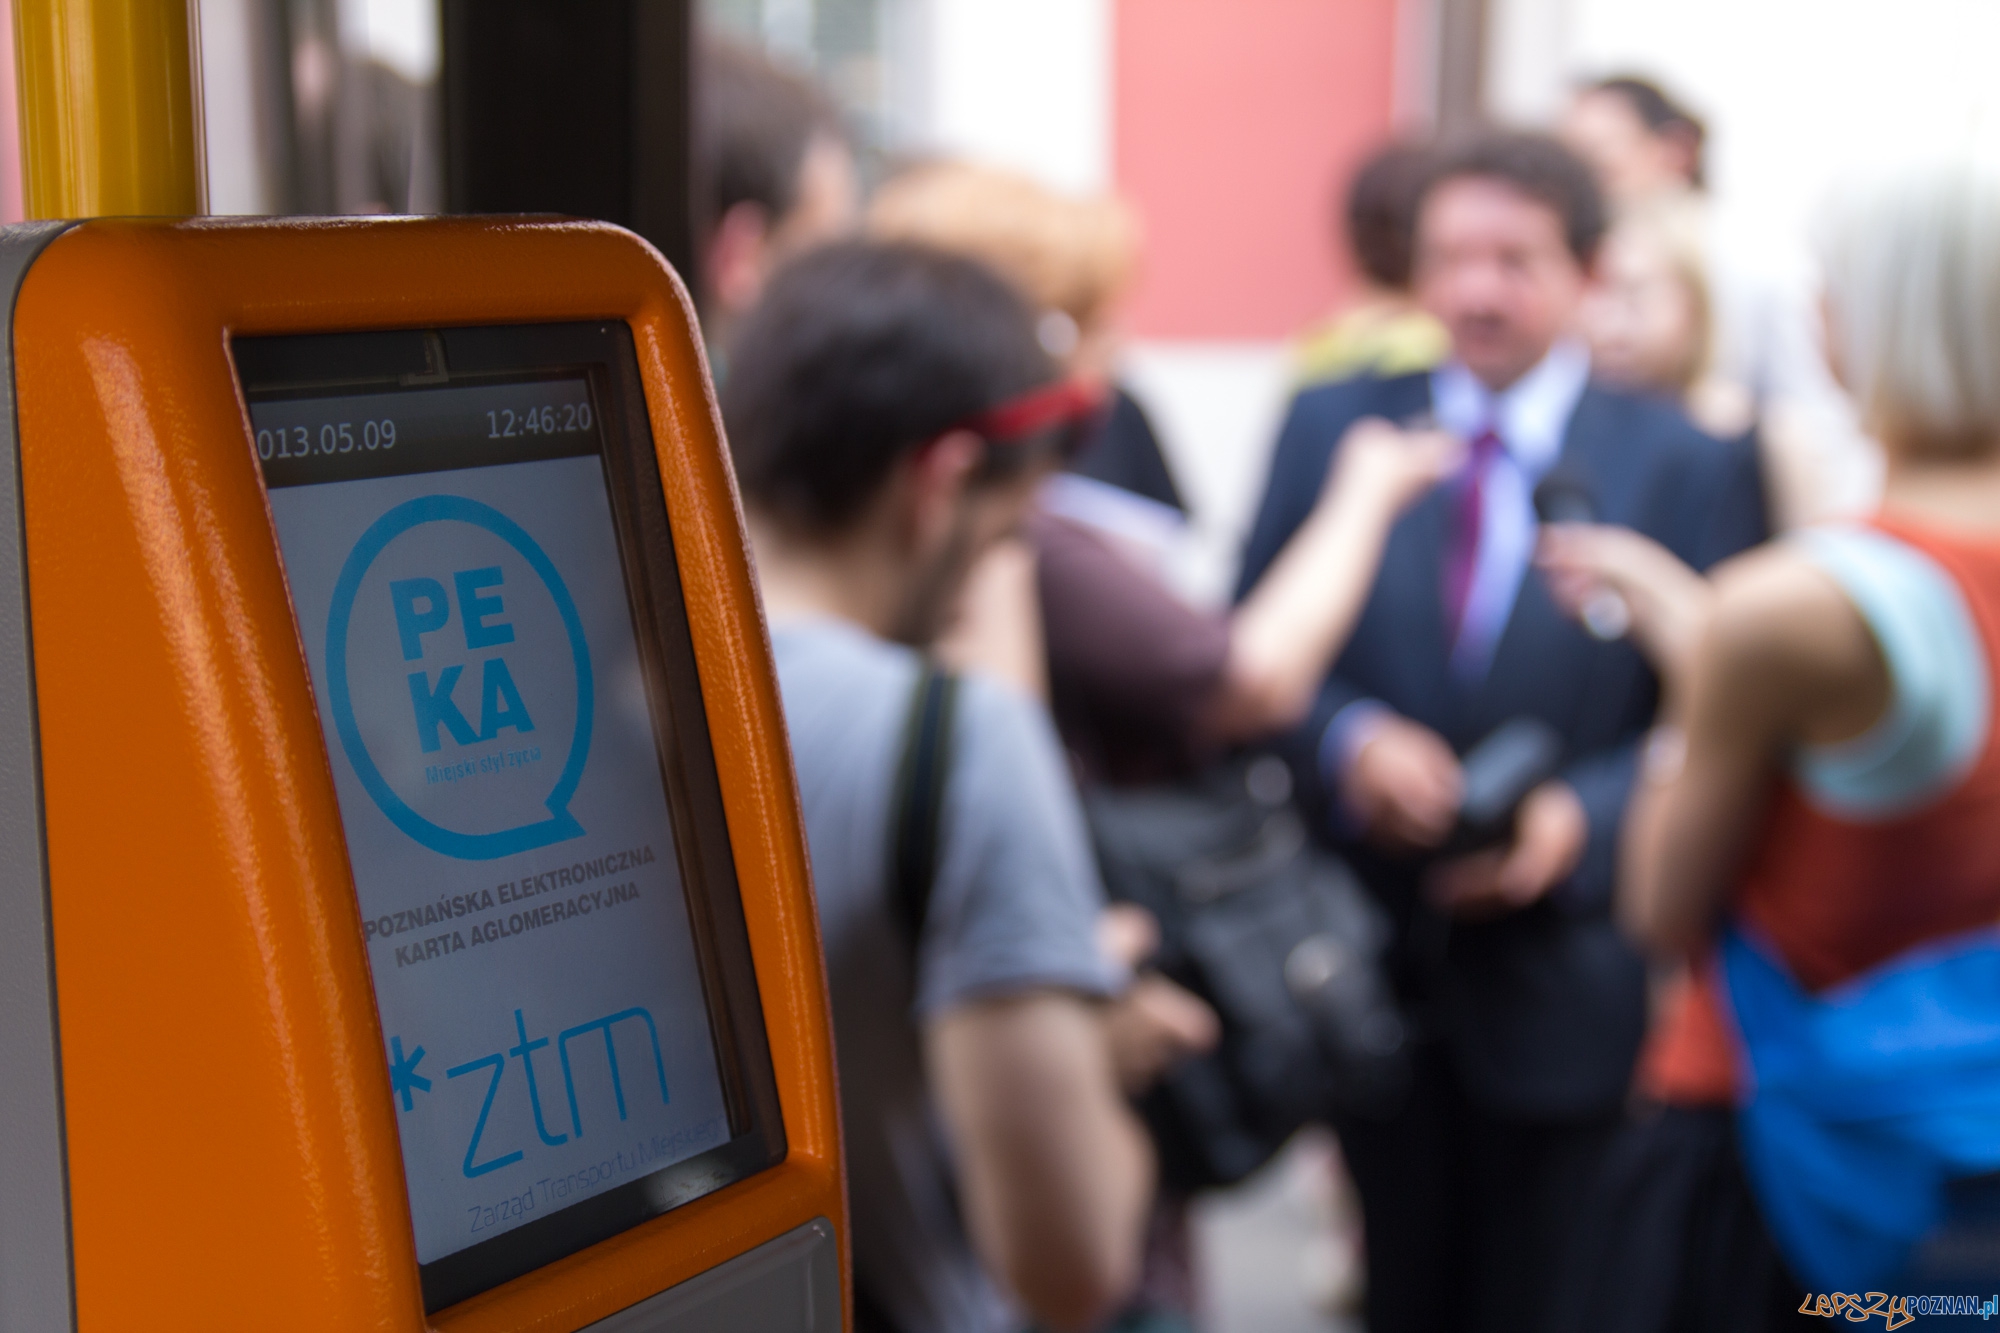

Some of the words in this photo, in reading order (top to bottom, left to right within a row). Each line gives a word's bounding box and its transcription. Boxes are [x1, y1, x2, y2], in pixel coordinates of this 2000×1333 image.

[257, 419, 396, 460] 013.05.09
[486, 402, 592, 439] 12:46:20
[389, 565, 515, 661] PE
[407, 657, 535, 754] KA
[425, 756, 476, 784] Miejski
[363, 889, 494, 941] POZNAŃSKA
[497, 845, 655, 905] ELEKTRONICZNA
[395, 931, 465, 968] KARTA
[471, 882, 640, 947] AGLOMERACYJNA
[468, 1186, 535, 1233] Zarząd
[537, 1151, 634, 1203] Transportu
